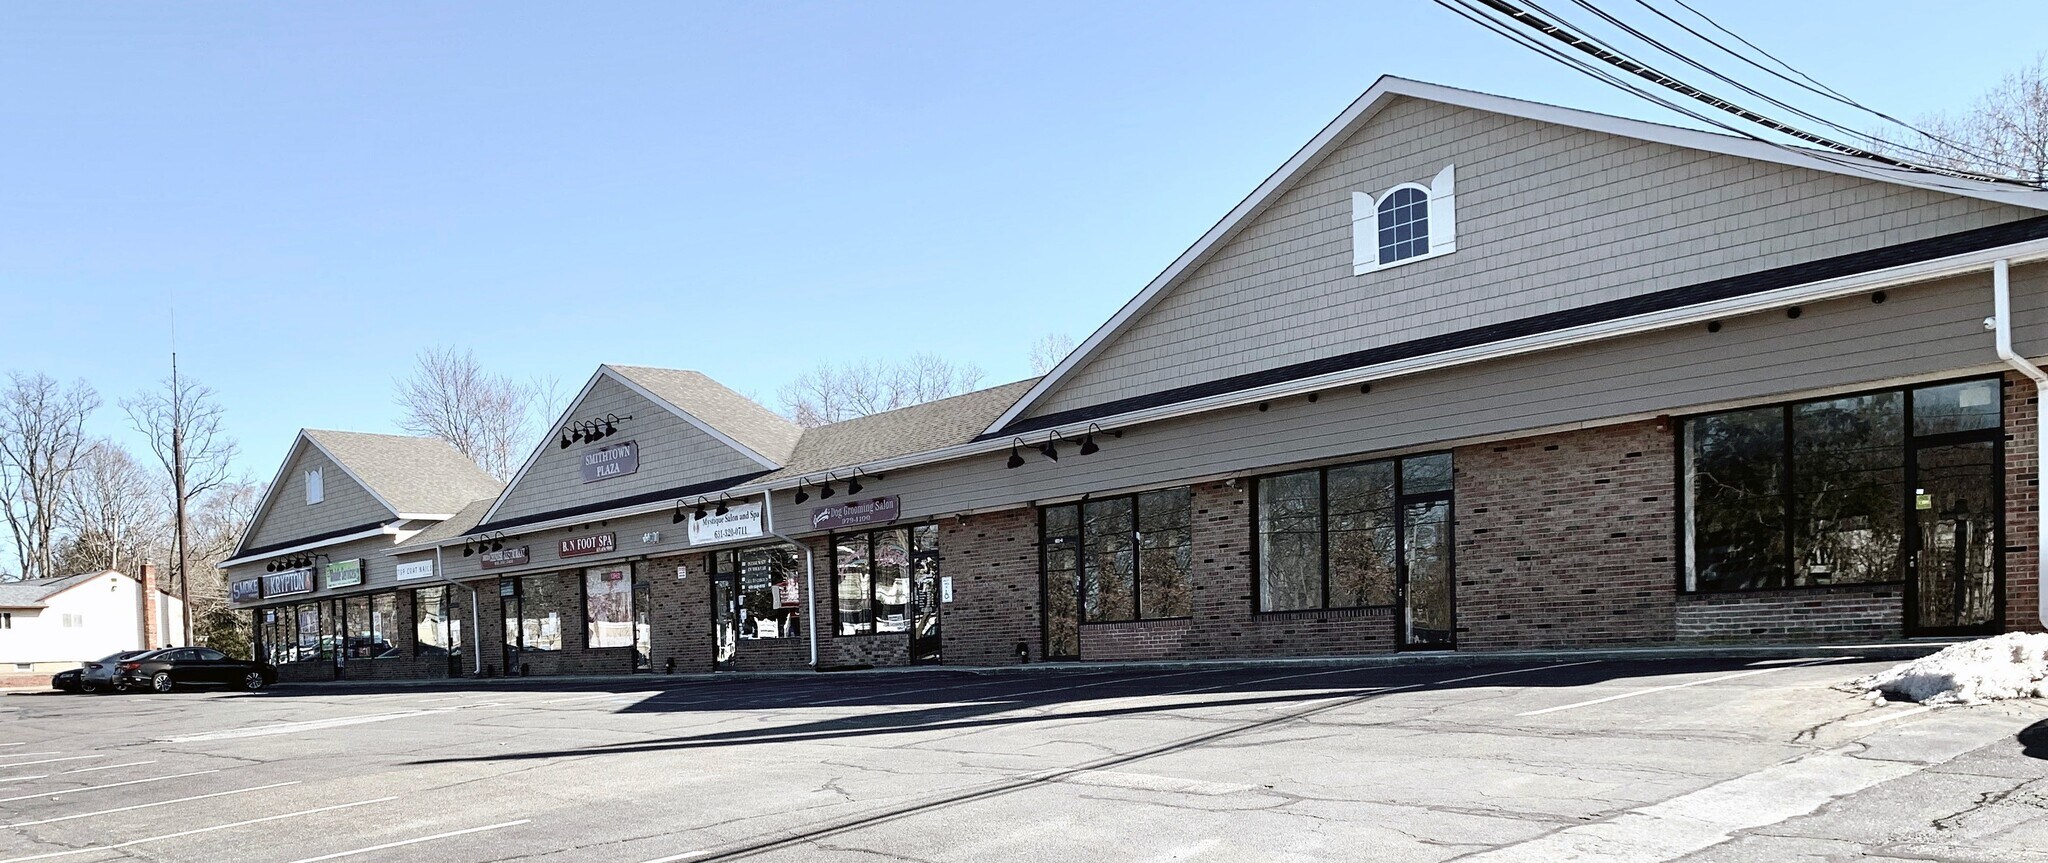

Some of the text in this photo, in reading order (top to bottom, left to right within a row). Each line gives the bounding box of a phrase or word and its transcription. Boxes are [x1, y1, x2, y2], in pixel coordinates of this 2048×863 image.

[585, 445, 630, 466] SMITHTOWN
[596, 462, 620, 477] PLAZA
[831, 507, 843, 519] Dog
[843, 502, 874, 516] Grooming
[874, 499, 894, 511] Salon
[702, 510, 760, 527] Mystique Salon and Spa
[577, 537, 596, 550] FOOT
[598, 535, 612, 547] SPA
[407, 566, 417, 575] COAT
[233, 579, 258, 599] SMOKE
[270, 571, 305, 594] KRYPTON
